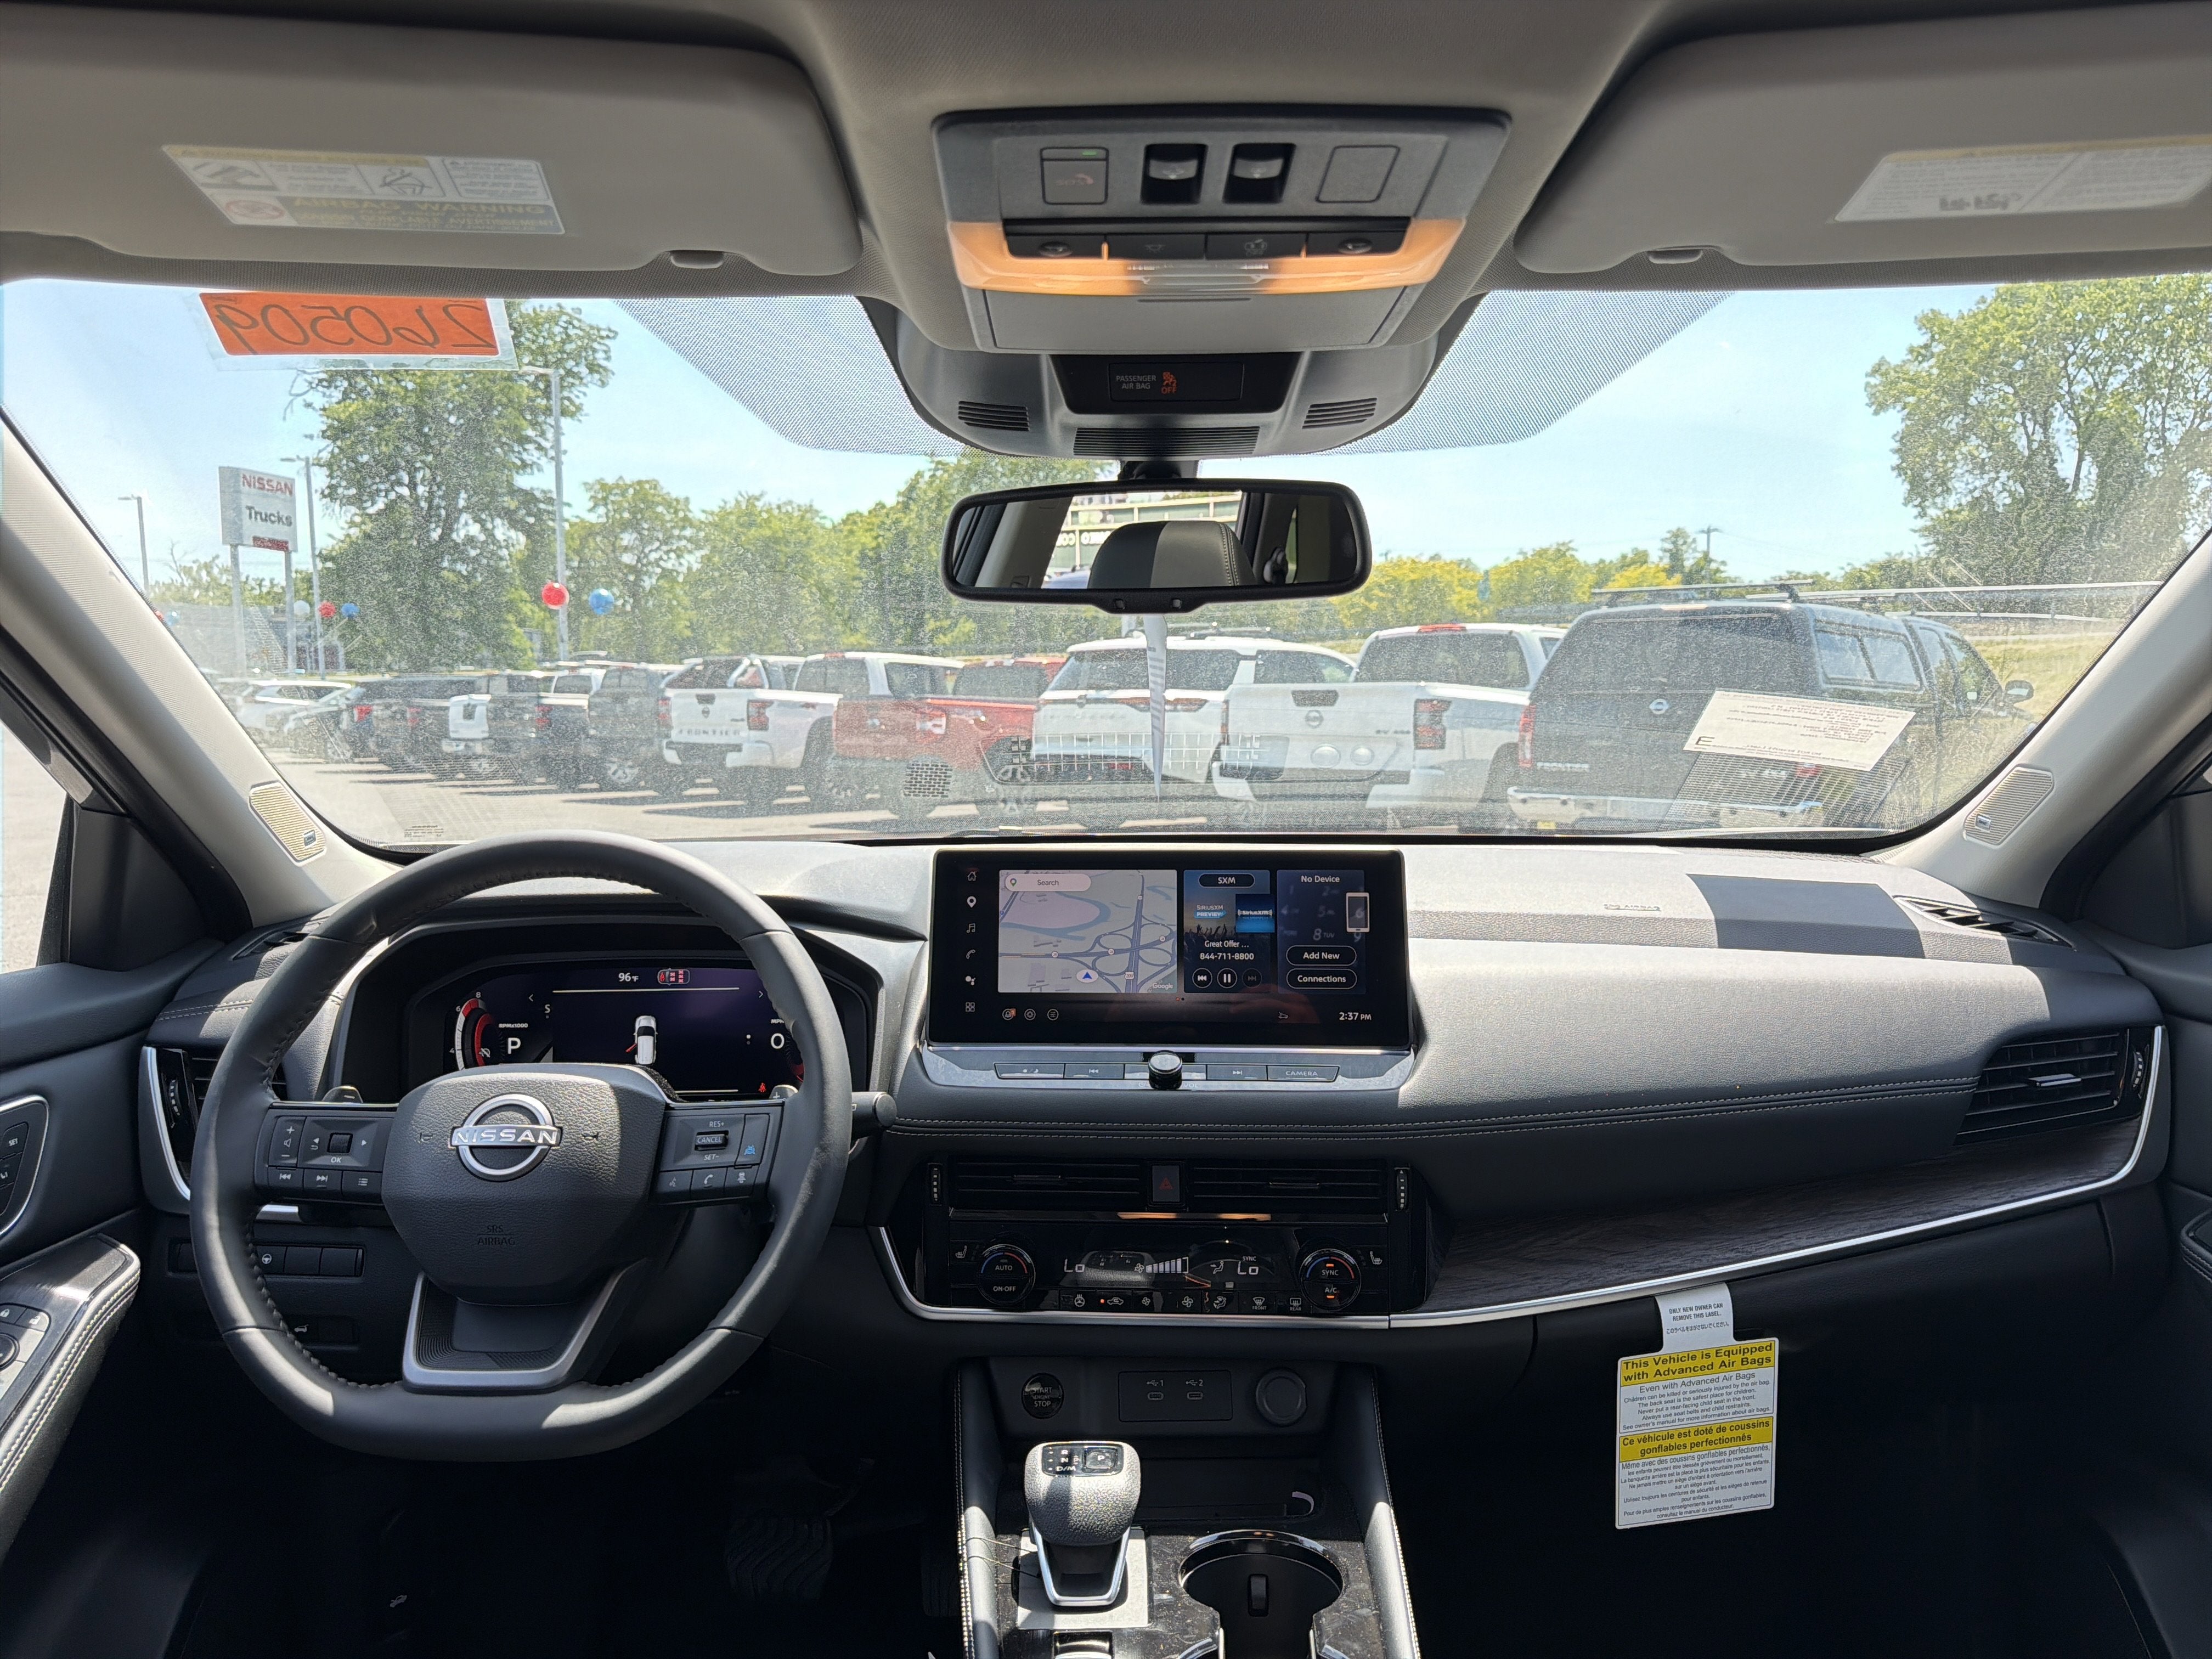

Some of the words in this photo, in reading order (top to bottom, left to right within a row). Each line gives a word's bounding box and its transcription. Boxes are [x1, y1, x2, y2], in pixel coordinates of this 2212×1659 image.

[416, 201, 545, 214] WARNING
[241, 473, 293, 496] NISSAN
[245, 505, 292, 527] Trucks
[1313, 928, 1322, 941] 8
[1297, 974, 1346, 983] Connections
[544, 1004, 551, 1013] S
[507, 1037, 521, 1054] P
[8, 1137, 18, 1147] SET
[454, 1128, 557, 1144] NISSAN
[486, 1225, 504, 1233] SRS
[477, 1237, 516, 1245] AIRBAG
[1623, 1359, 1649, 1370] This
[1652, 1353, 1697, 1365] Vehicle
[1701, 1351, 1711, 1359] is
[1715, 1342, 1772, 1358] Equipped
[1623, 1370, 1648, 1382] with
[1653, 1362, 1714, 1378] Advanced
[1718, 1359, 1736, 1369] Air
[1741, 1356, 1771, 1366] Bags
[1662, 1381, 1678, 1390] with
[1680, 1375, 1719, 1387] Advanced
[1722, 1374, 1733, 1383] Air
[1622, 1437, 1634, 1446] Ce
[1637, 1431, 1674, 1444] véhicule
[1677, 1429, 1691, 1438] est
[1693, 1426, 1713, 1436] doté
[1716, 1424, 1726, 1434] de
[1729, 1420, 1770, 1431] coussins
[1640, 1442, 1687, 1457] gonflables
[1690, 1433, 1751, 1451] perfectionnés
[1669, 1454, 1695, 1463] coussins
[1696, 1449, 1727, 1461] gonflables
[1728, 1444, 1770, 1457] perfectionnés,
